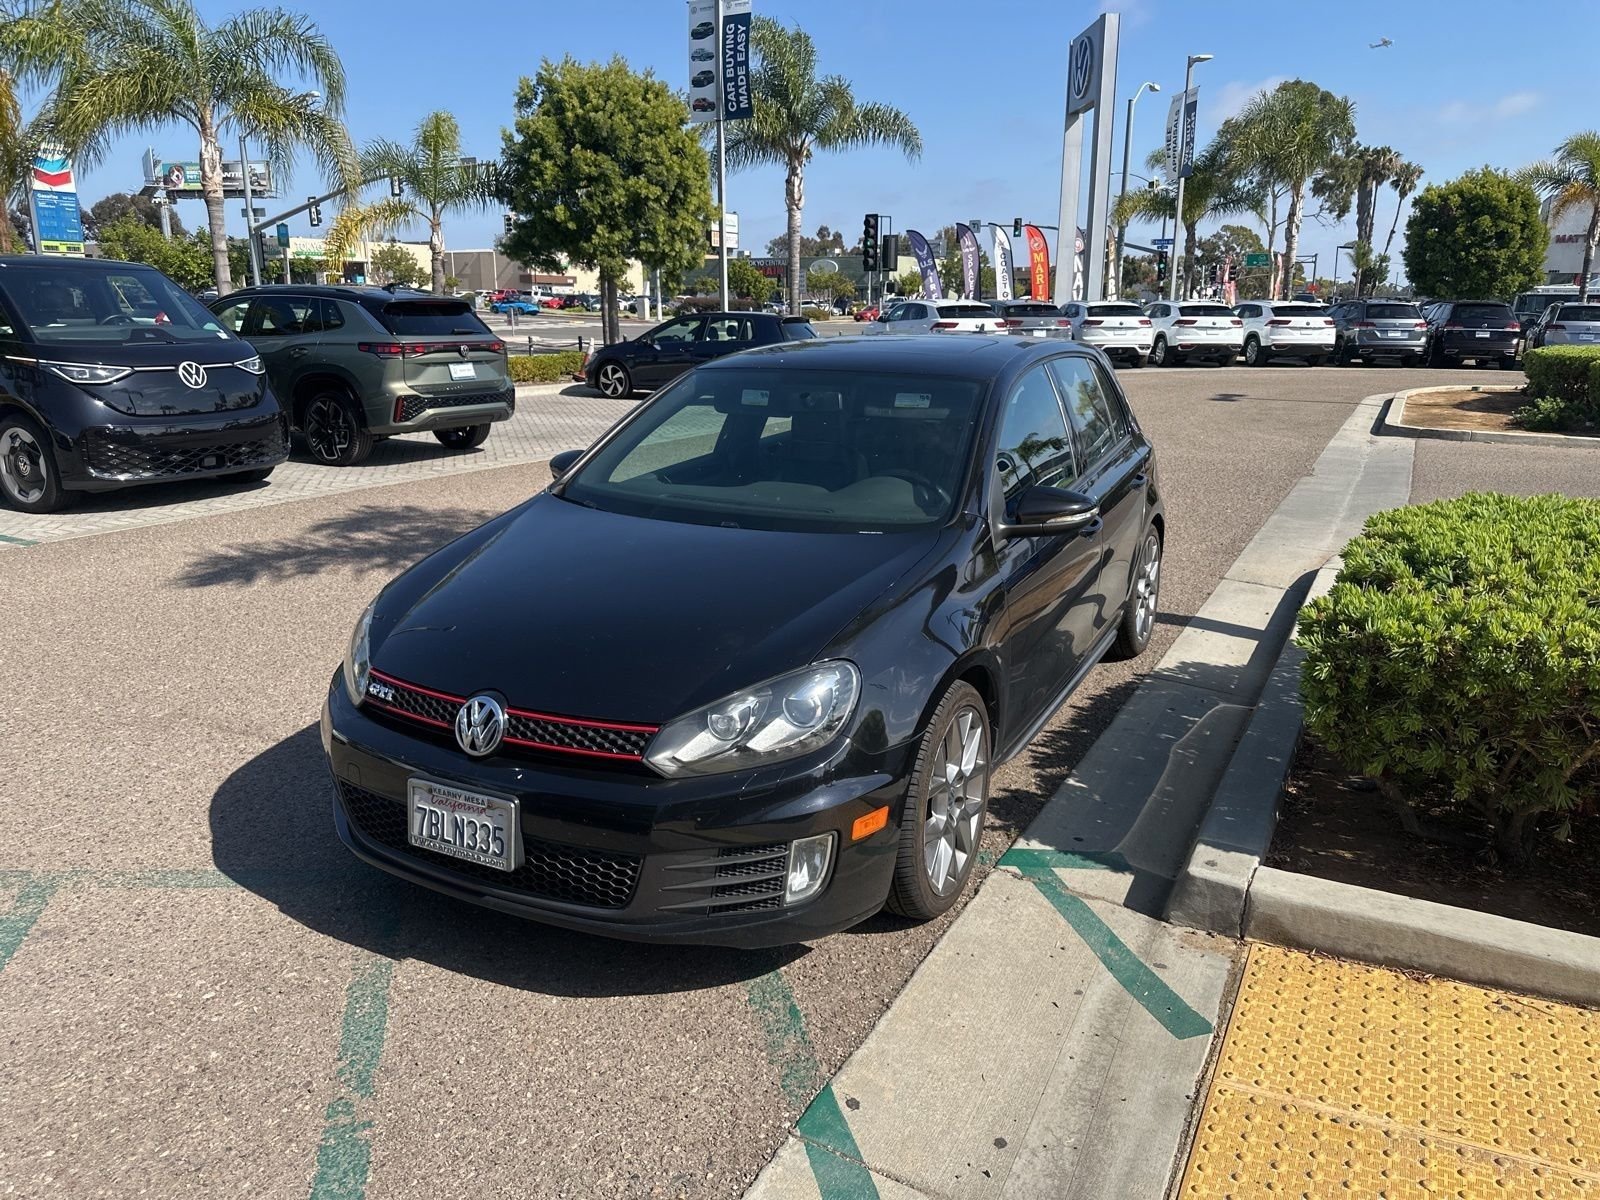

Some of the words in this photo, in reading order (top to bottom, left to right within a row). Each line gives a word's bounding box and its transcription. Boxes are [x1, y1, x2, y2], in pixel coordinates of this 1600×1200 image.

[726, 24, 735, 78] BUYING
[737, 24, 746, 62] EASY
[726, 82, 736, 112] CAR
[737, 65, 748, 108] MADE
[927, 269, 937, 292] AIR
[1000, 252, 1008, 289] COAST
[1033, 252, 1044, 301] MARIN
[1072, 254, 1084, 301] NAV
[370, 682, 394, 702] GTI
[431, 794, 490, 817] California
[432, 787, 462, 799] KEARNY
[465, 794, 485, 806] MESA
[415, 804, 504, 858] 7BLN335
